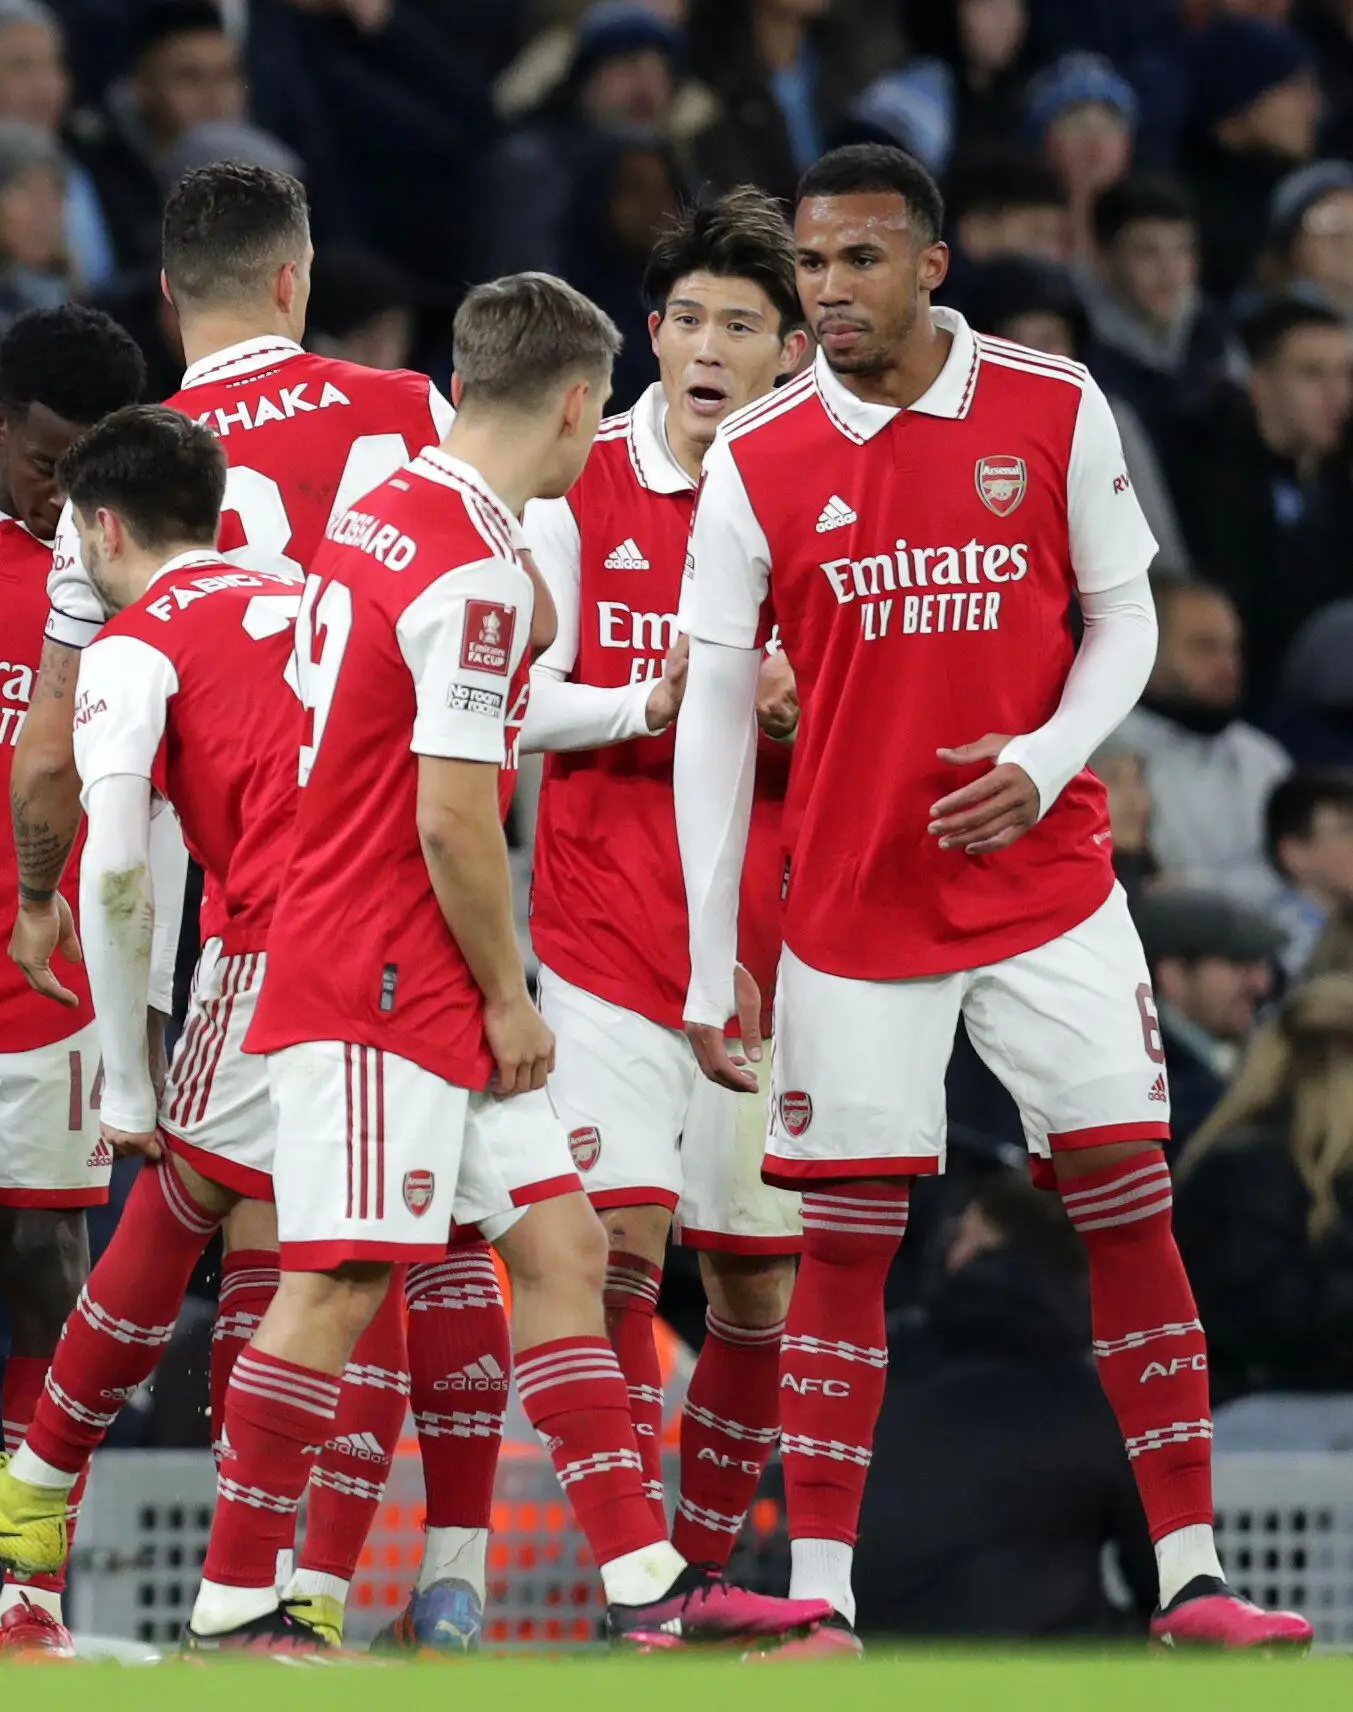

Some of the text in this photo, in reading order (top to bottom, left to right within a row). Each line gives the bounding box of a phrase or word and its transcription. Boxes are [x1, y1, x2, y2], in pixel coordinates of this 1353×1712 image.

[982, 465, 1020, 475] Arsenal
[604, 557, 650, 570] adidas
[819, 537, 1029, 605] Emirates
[902, 591, 1001, 635] BETTER
[468, 651, 505, 667] FA CUP
[448, 684, 469, 701] No
[1139, 1353, 1207, 1383] AFC
[432, 1376, 508, 1391] adidas
[780, 1372, 851, 1397] AFC
